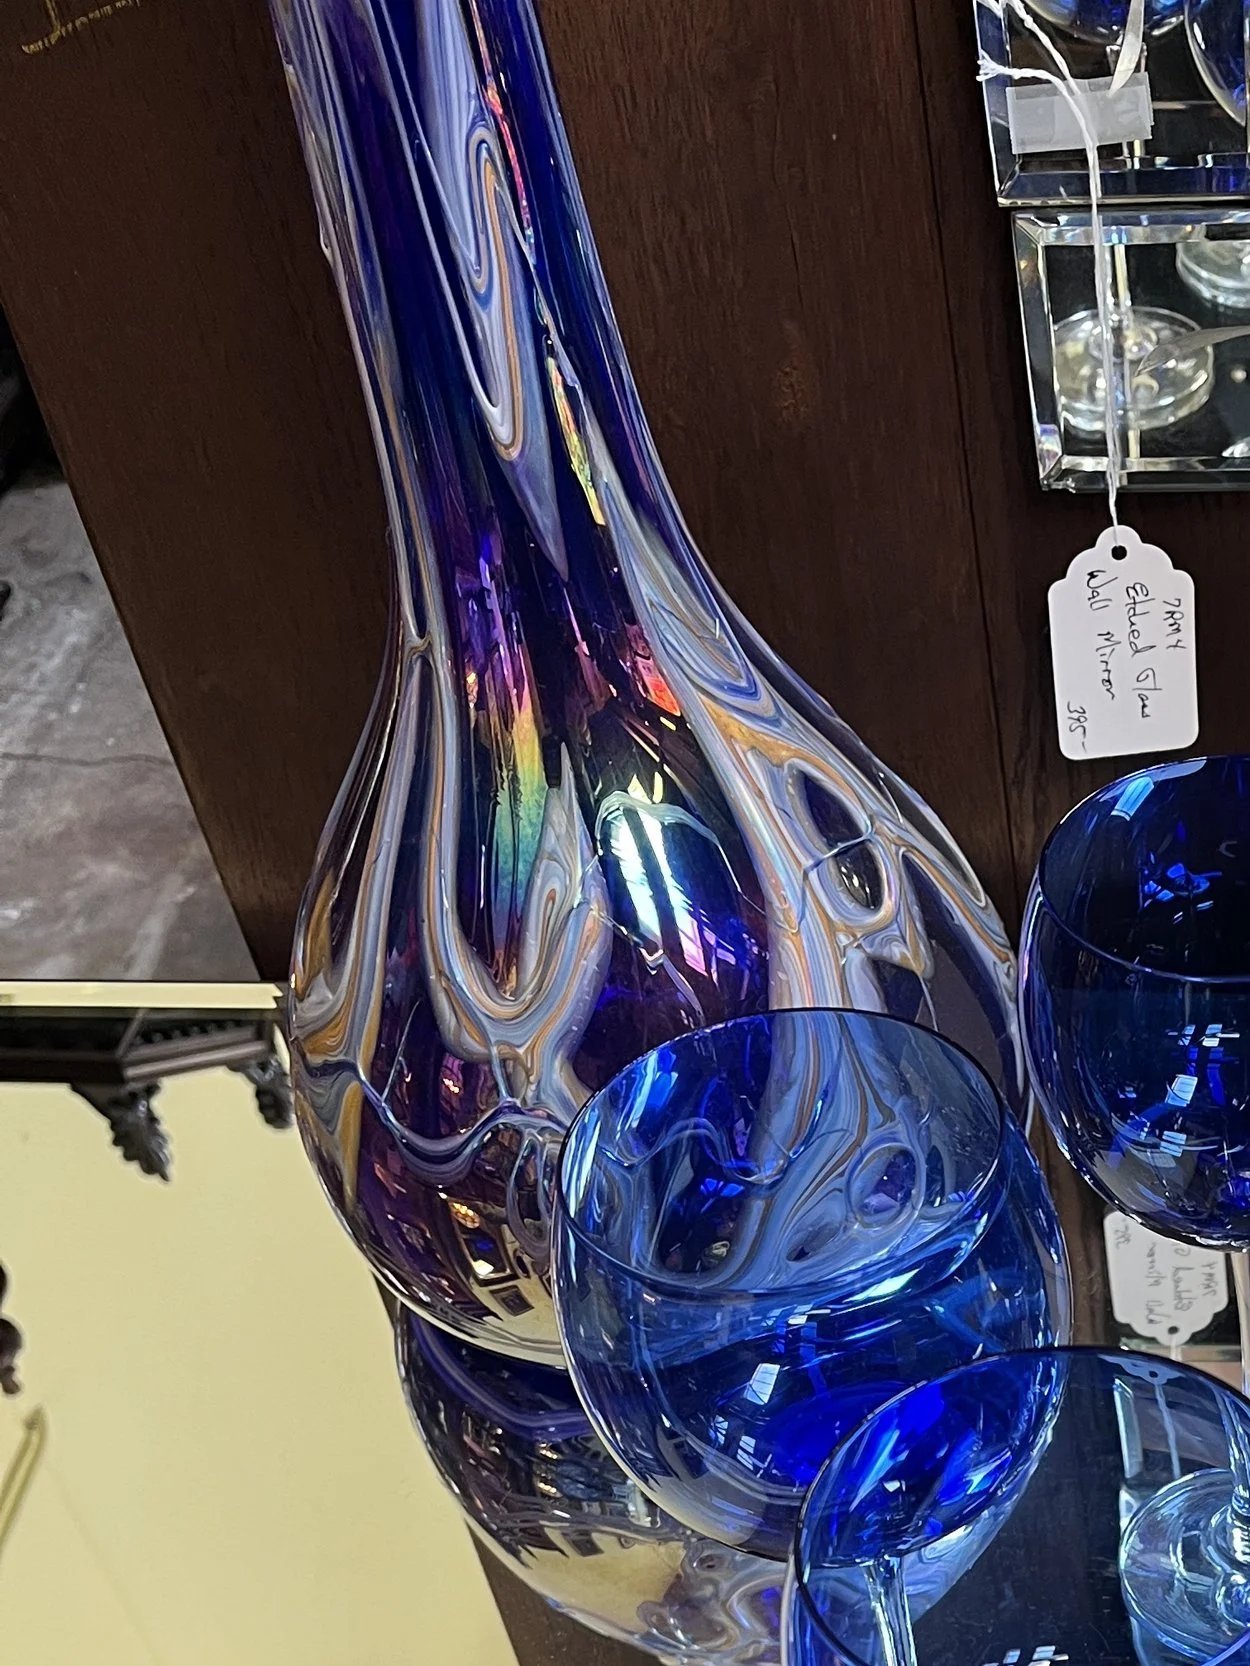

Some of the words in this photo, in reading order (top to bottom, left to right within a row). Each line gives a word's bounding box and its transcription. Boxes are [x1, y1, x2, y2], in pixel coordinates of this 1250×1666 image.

[1086, 570, 1118, 611] Wall
[1125, 582, 1157, 657] Etched
[1096, 631, 1121, 700] Mirror
